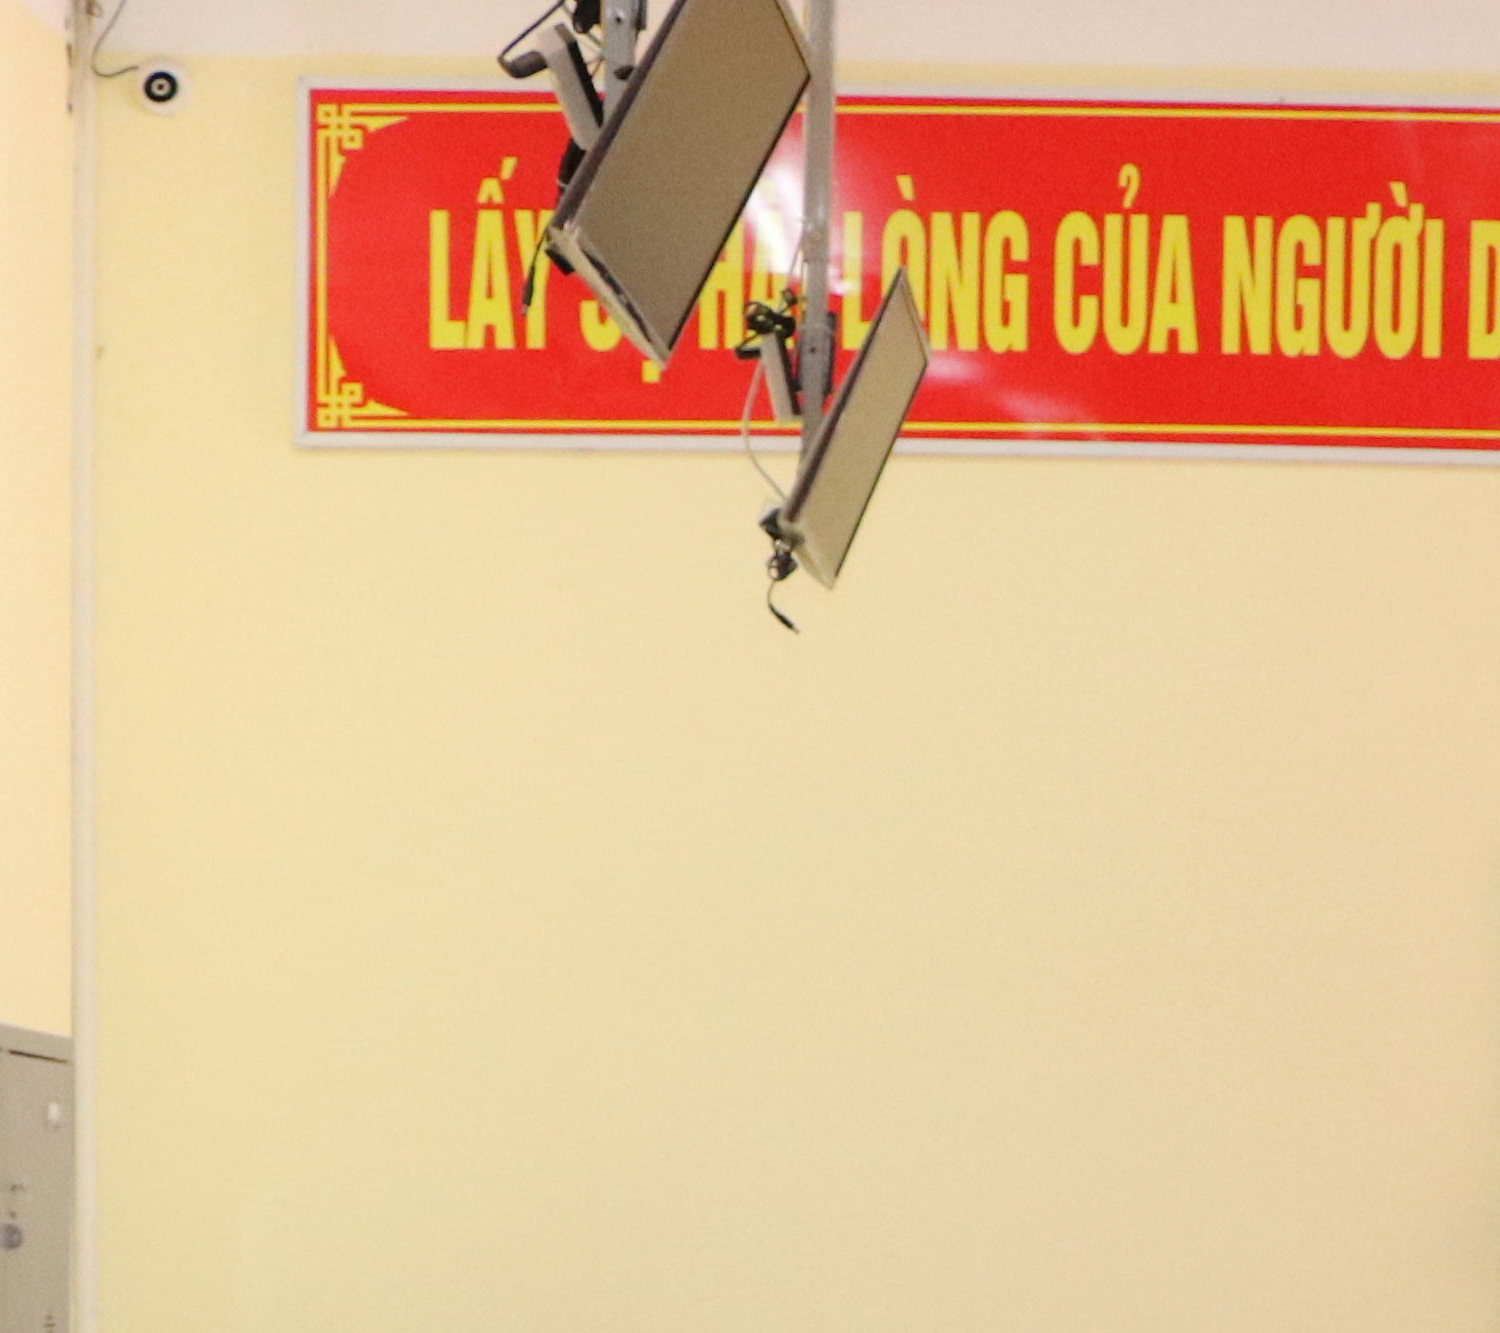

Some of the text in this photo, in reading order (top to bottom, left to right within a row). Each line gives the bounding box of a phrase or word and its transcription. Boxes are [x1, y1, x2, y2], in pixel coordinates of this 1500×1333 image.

[429, 157, 556, 350] LẤY
[842, 175, 1029, 352] LÒNG
[1056, 165, 1196, 353] CỦA
[1223, 183, 1442, 358] NGƯỜI
